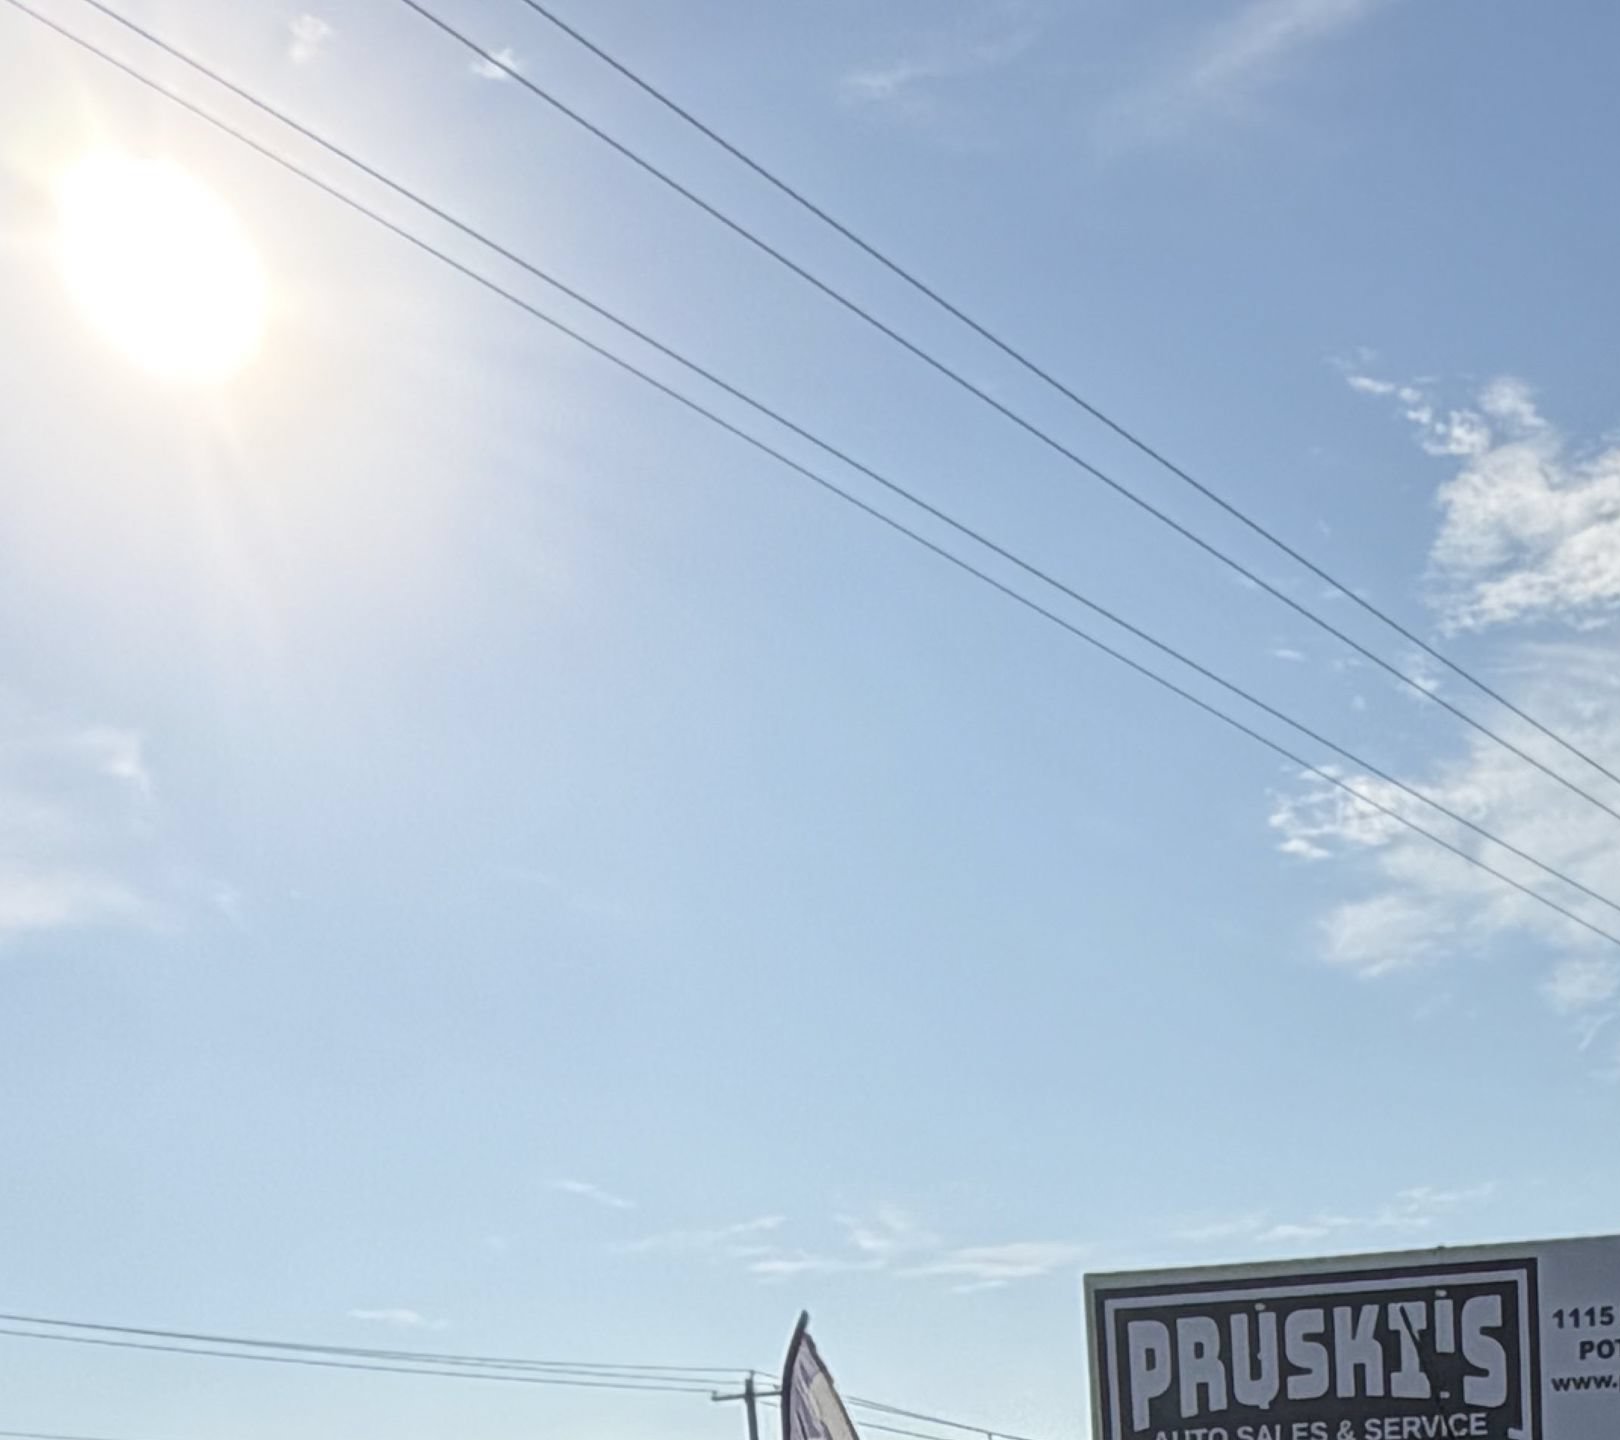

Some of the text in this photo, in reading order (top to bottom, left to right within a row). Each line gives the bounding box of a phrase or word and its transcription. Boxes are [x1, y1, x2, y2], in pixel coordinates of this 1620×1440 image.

[1552, 1306, 1614, 1329] 1115
[1127, 1294, 1507, 1432] PRUSKI'S
[1364, 1412, 1488, 1440] SERVICE
